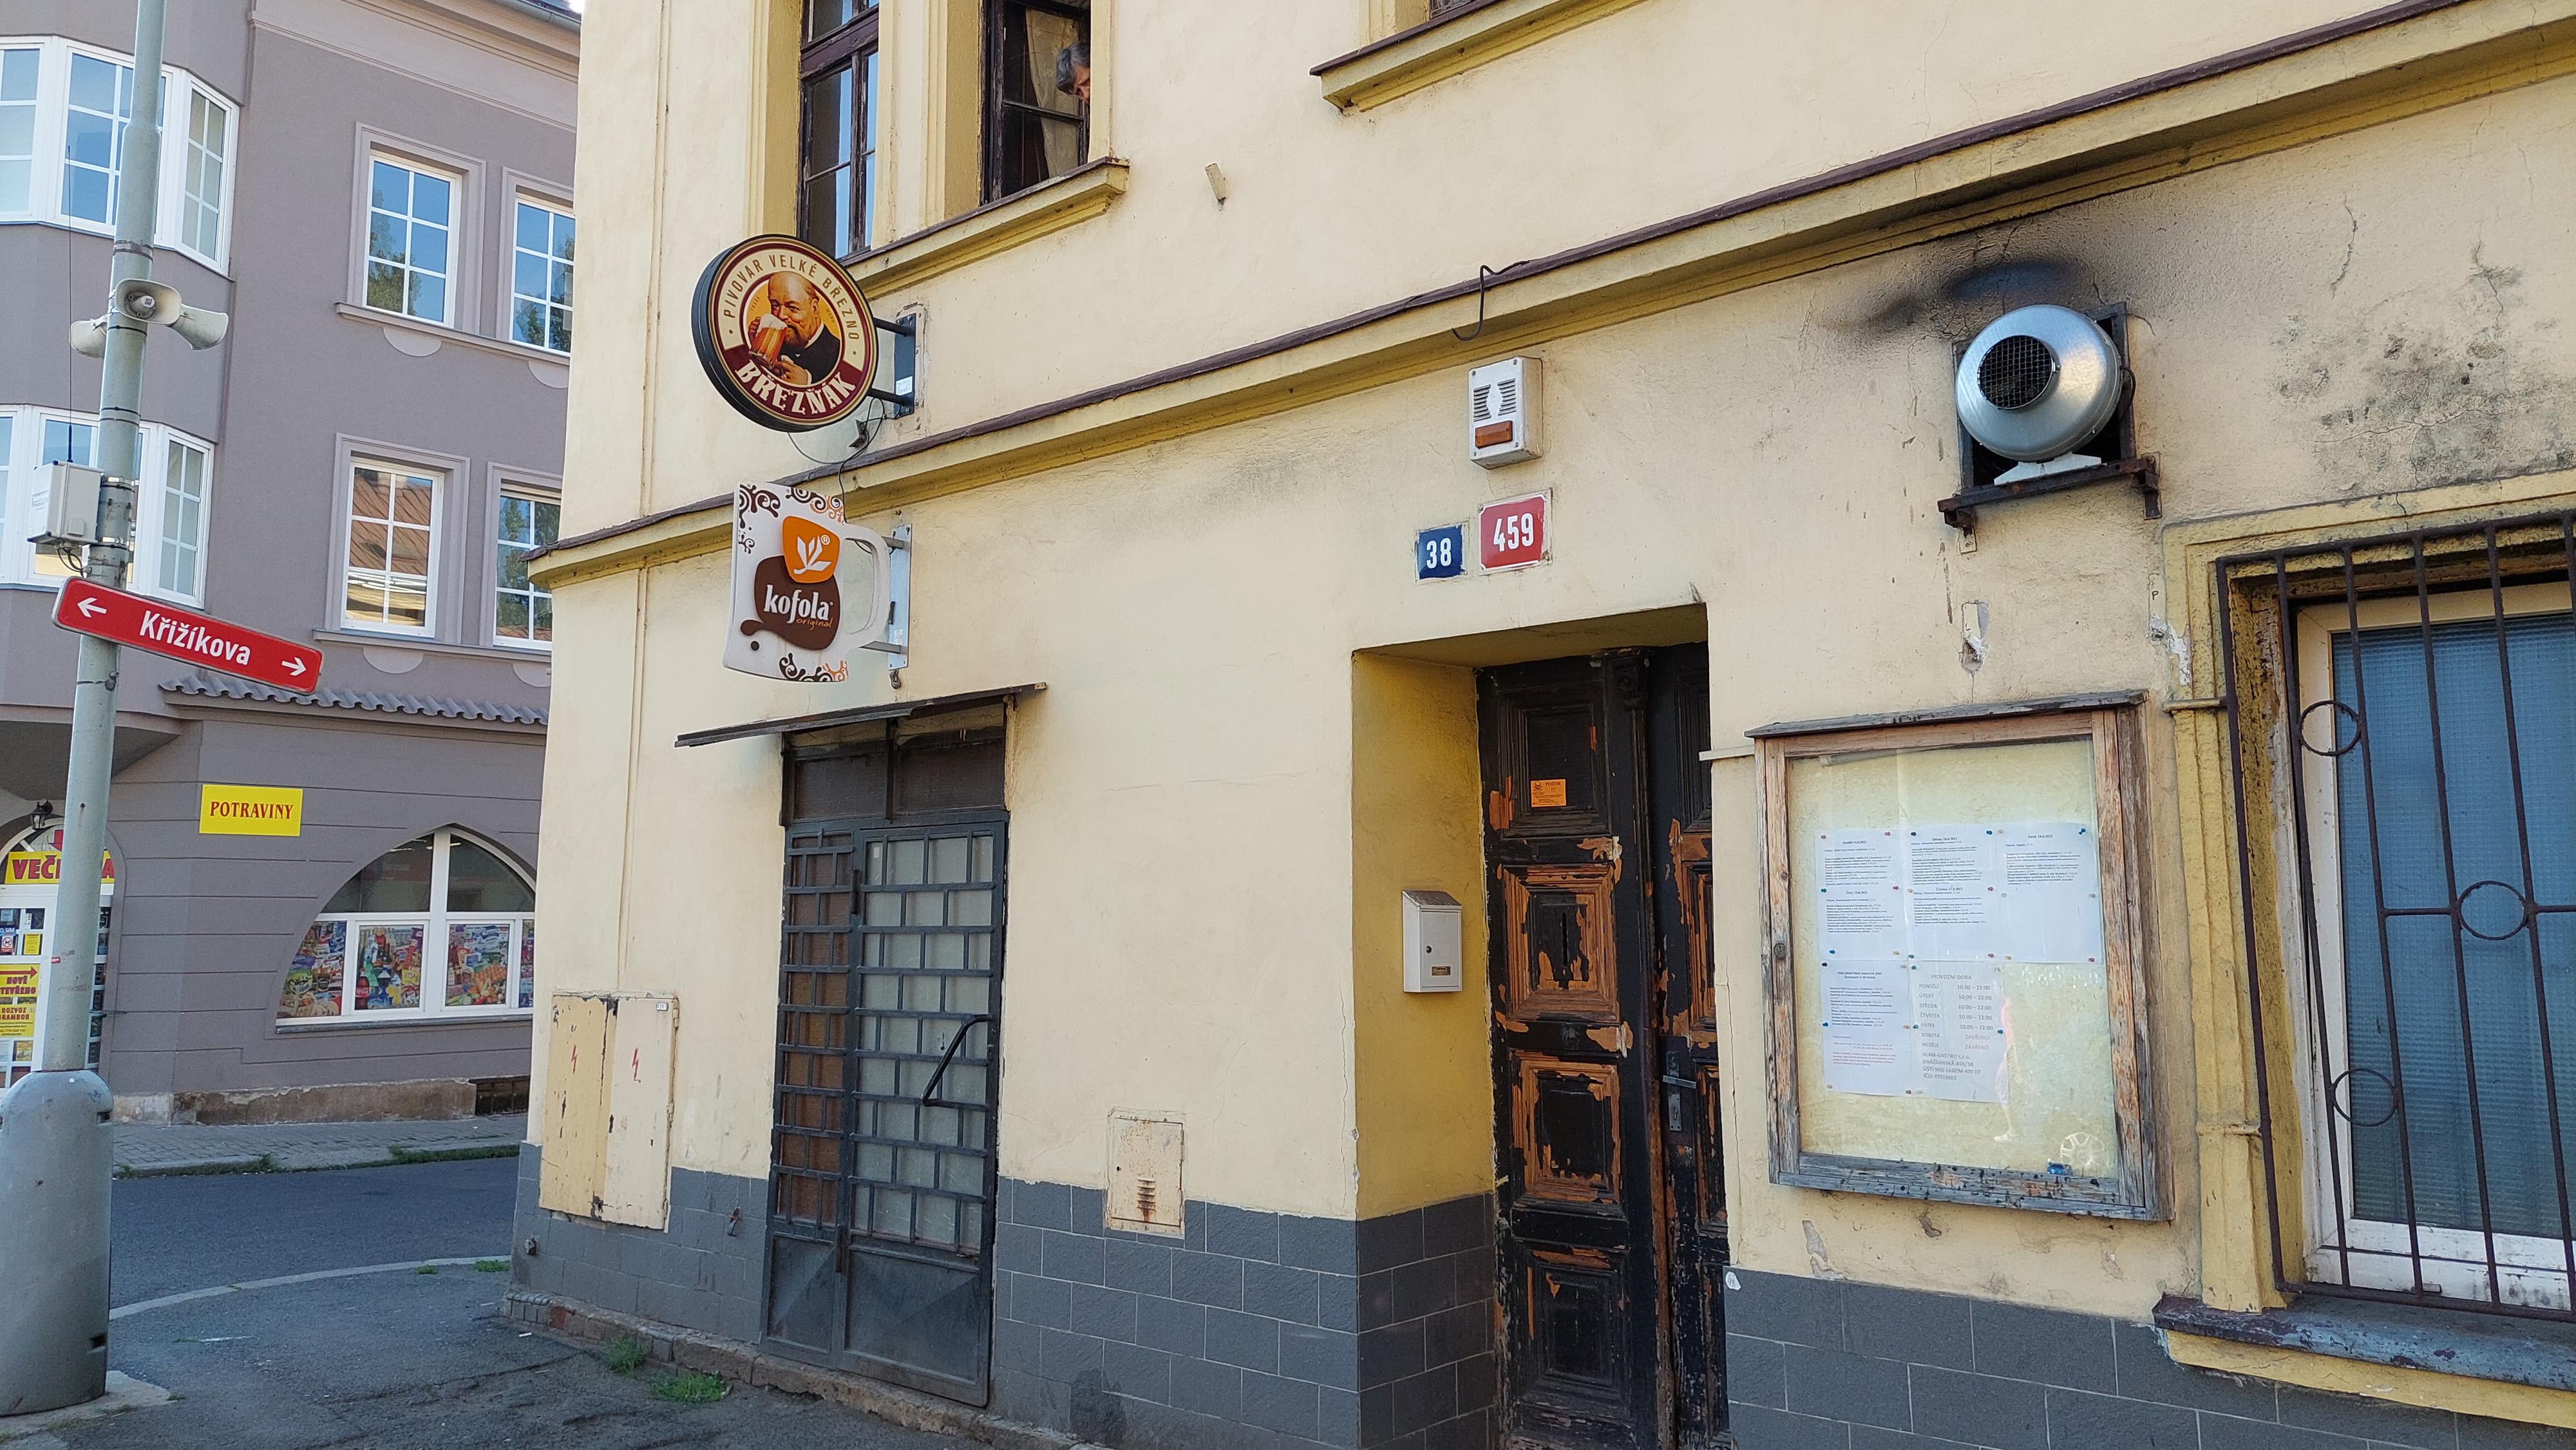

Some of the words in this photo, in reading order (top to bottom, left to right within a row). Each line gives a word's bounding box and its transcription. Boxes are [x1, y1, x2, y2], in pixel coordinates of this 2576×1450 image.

[723, 259, 764, 319] PIVOVAR
[768, 254, 818, 278] VELKÉ
[822, 278, 860, 340] BŘEZNO
[734, 359, 856, 415] BŘEZŇÁK
[1493, 513, 1534, 552] 459
[1426, 537, 1452, 569] 38
[763, 584, 830, 623] kofola
[139, 610, 251, 666] Křižíkova
[795, 617, 833, 631] original
[210, 801, 294, 820] POTRAVINY
[12, 855, 115, 880] VEČA
[0, 986, 36, 995] TEVŘENO
